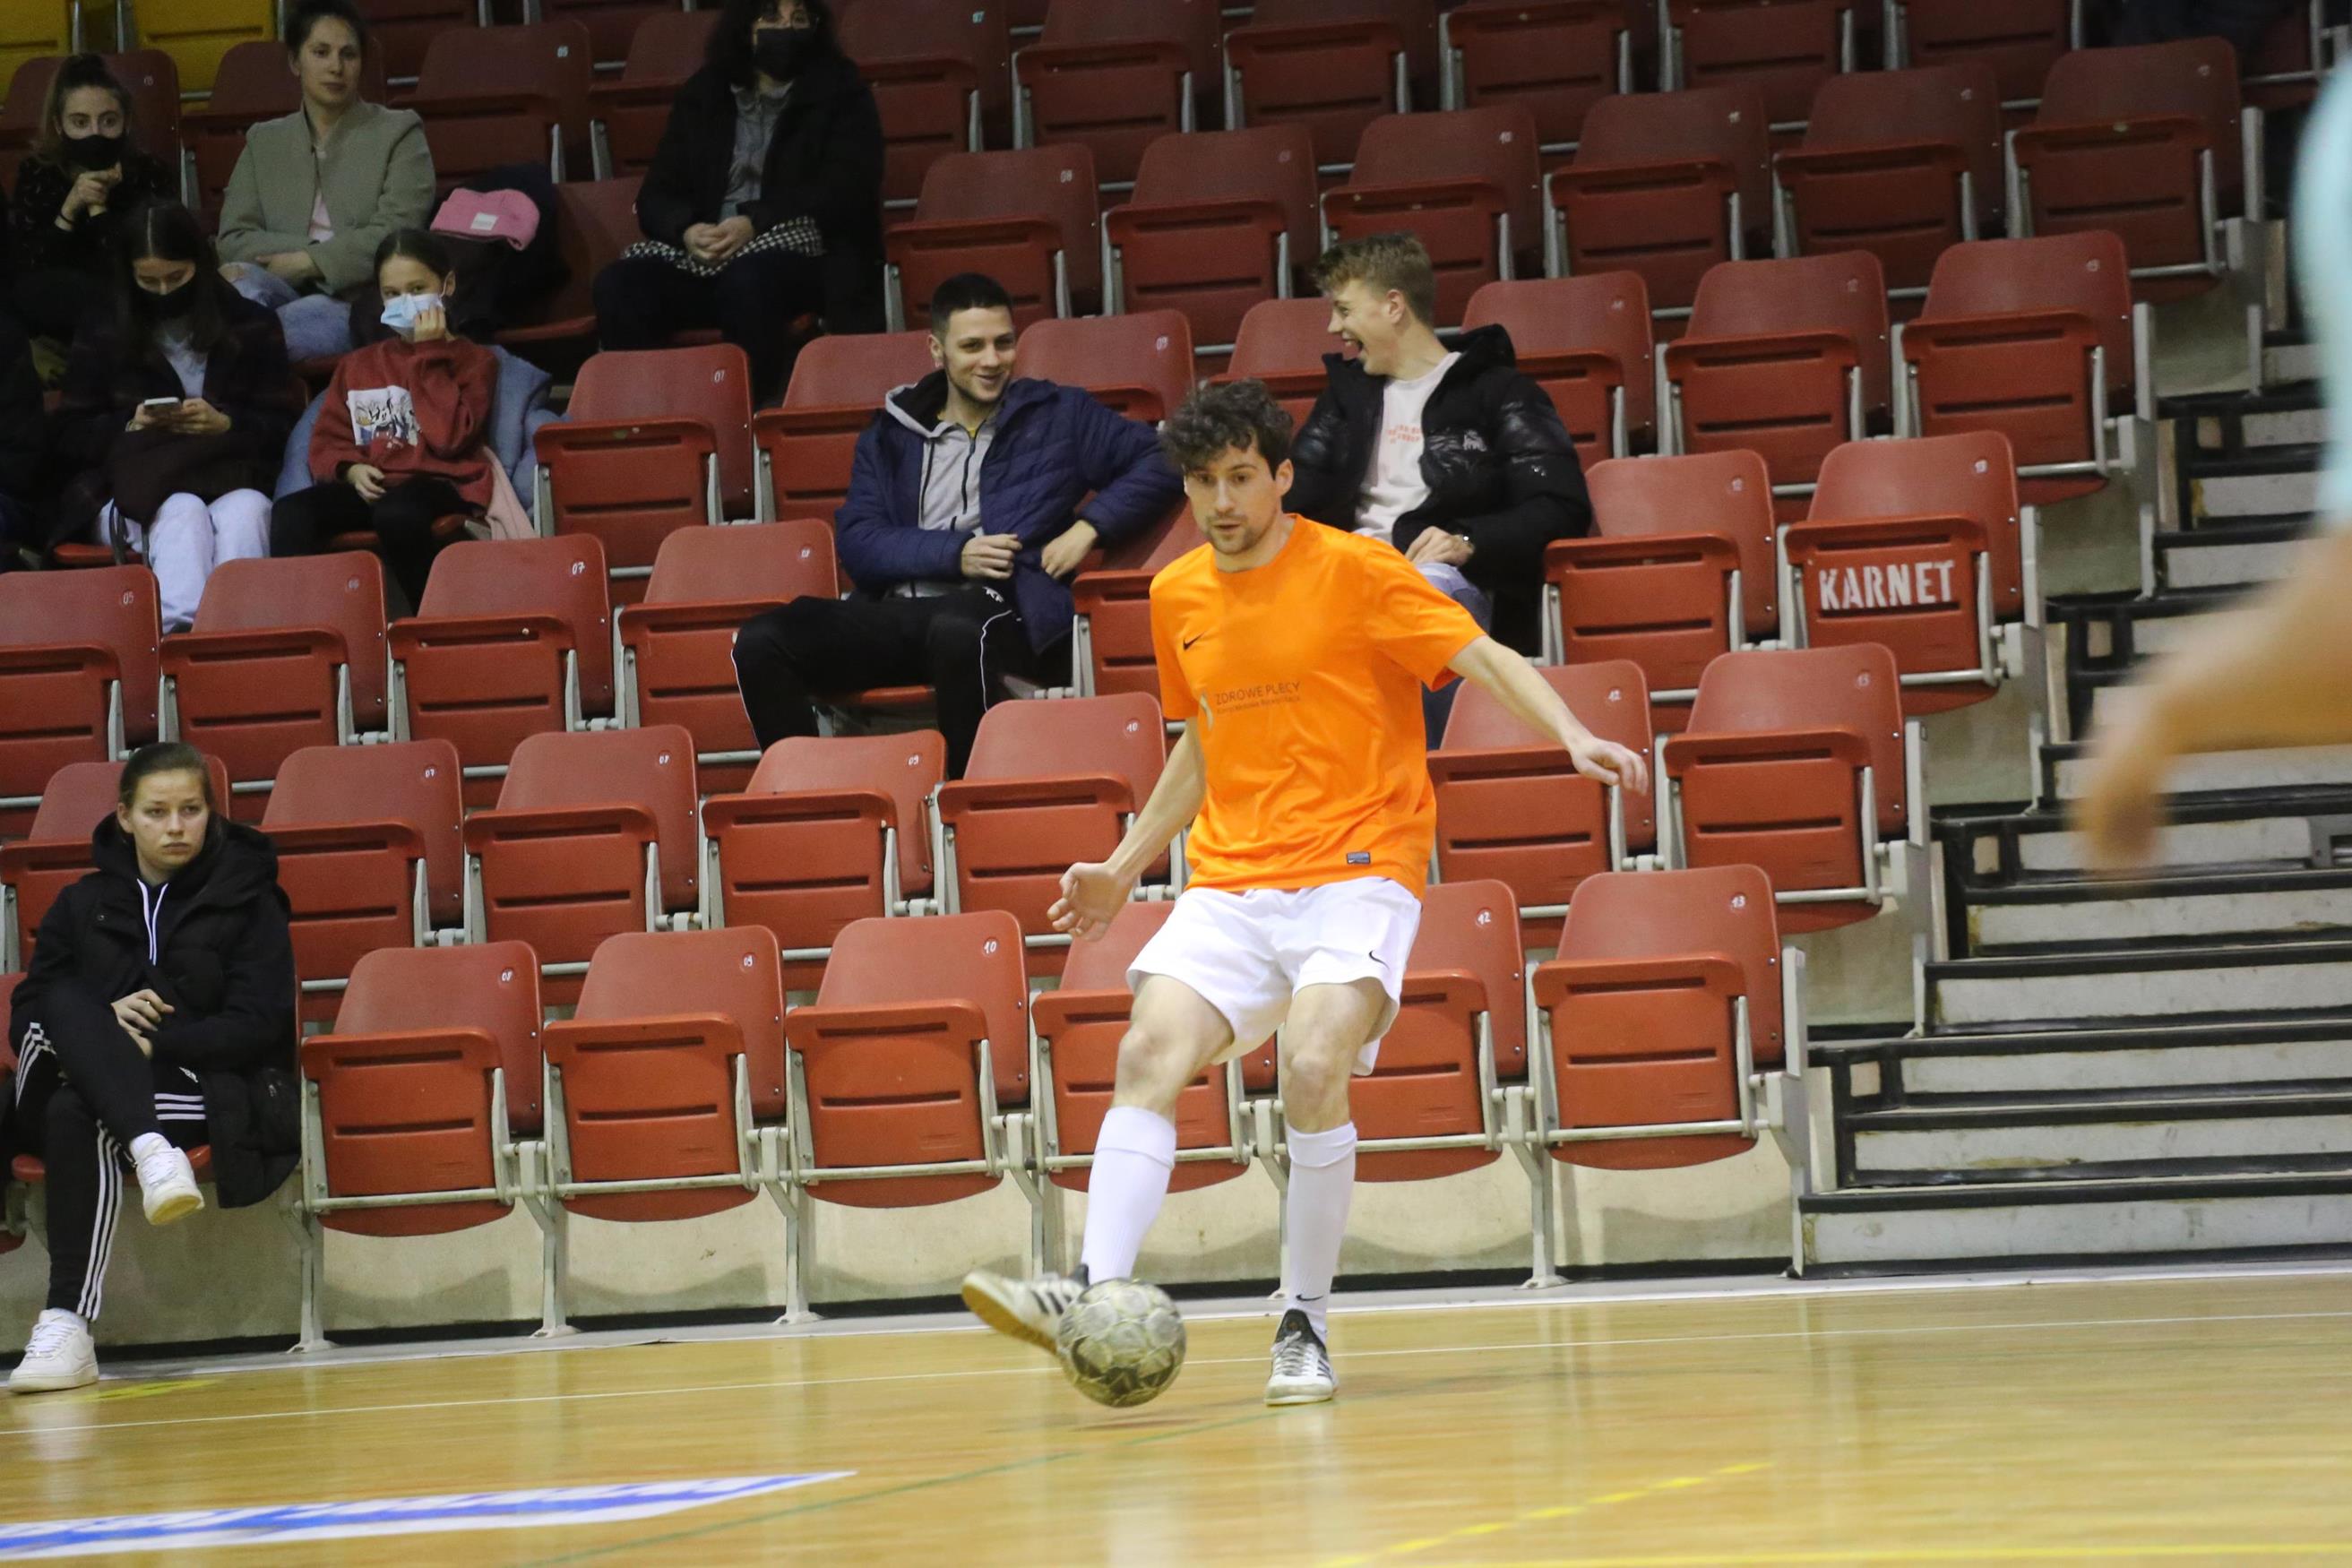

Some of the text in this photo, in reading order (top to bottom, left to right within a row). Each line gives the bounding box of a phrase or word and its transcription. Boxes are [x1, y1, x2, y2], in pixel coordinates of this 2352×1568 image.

[713, 370, 725, 383] 07
[572, 561, 586, 576] 07
[1819, 560, 1955, 610] KARNET
[123, 591, 134, 606] 05
[1214, 686, 1263, 706] ZDROWE
[1265, 681, 1301, 695] PLECY
[1126, 721, 1139, 733] 10
[1731, 895, 1745, 909] 13
[1477, 911, 1492, 926] 12
[983, 941, 997, 954] 10
